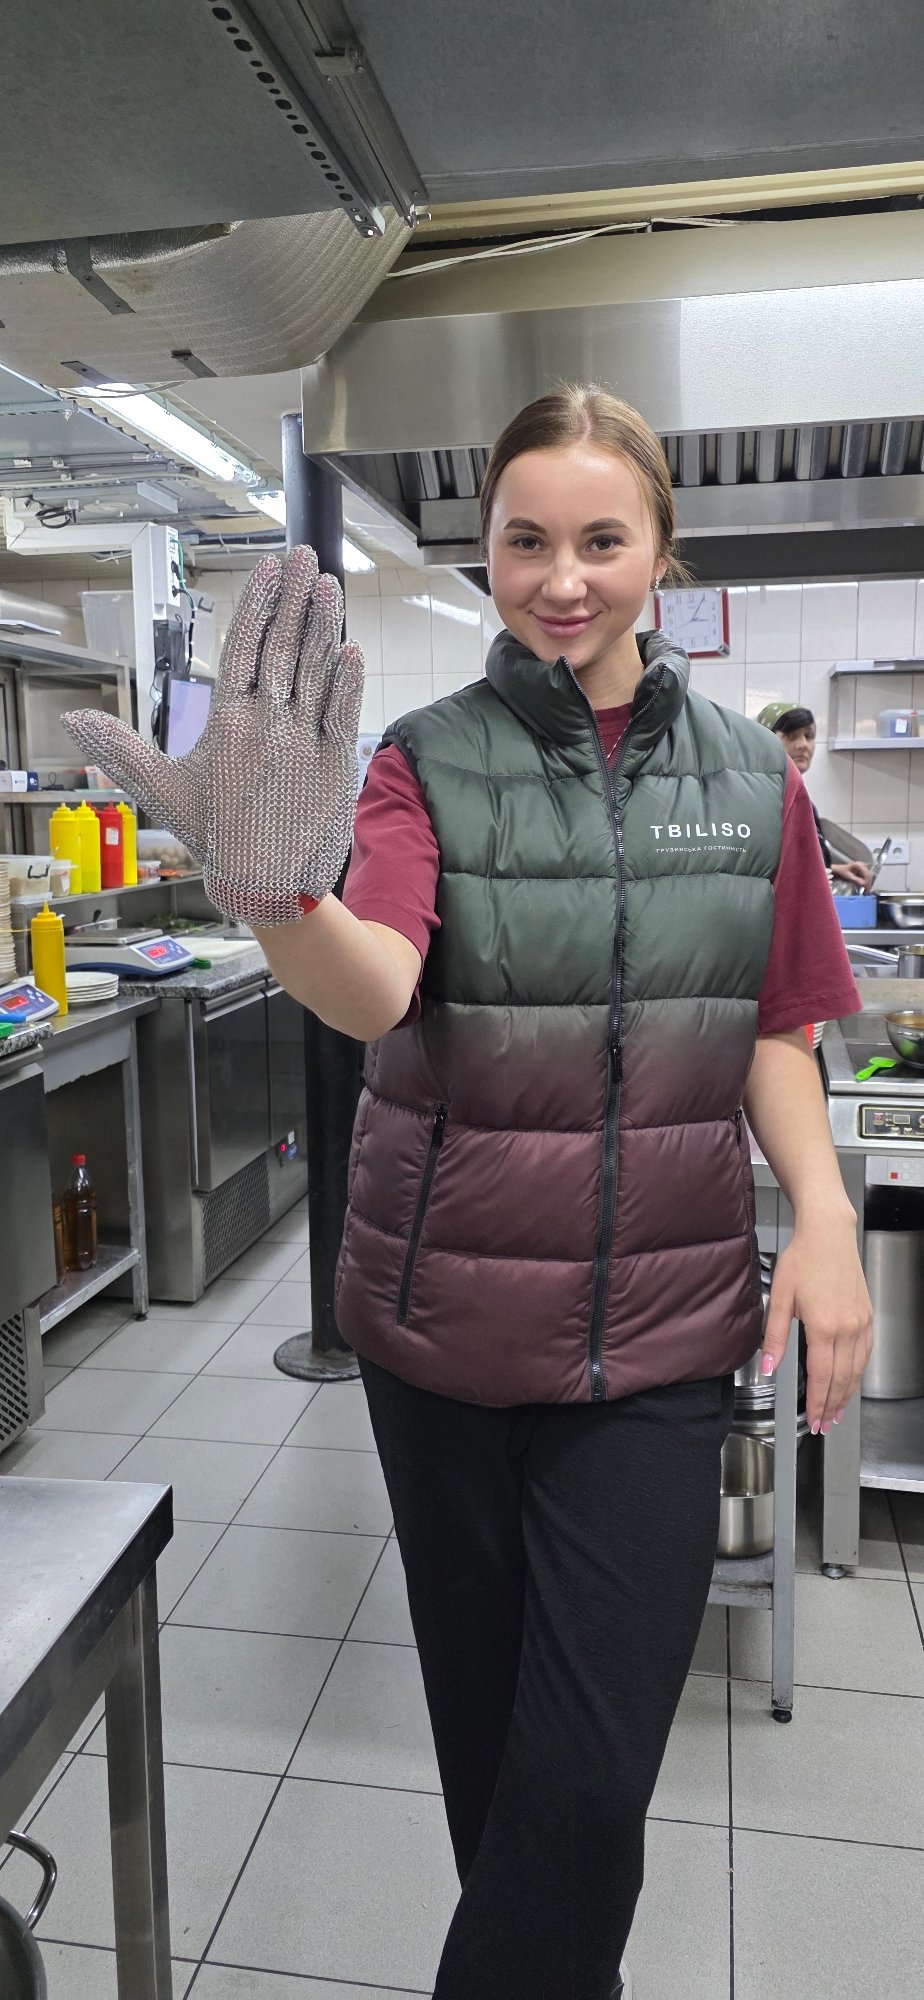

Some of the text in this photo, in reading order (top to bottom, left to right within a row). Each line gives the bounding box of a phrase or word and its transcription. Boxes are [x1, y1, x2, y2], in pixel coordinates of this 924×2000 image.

[676, 594, 682, 604] 11
[688, 594, 695, 604] 12
[711, 601, 716, 611] 2
[650, 822, 751, 840] TBILISO
